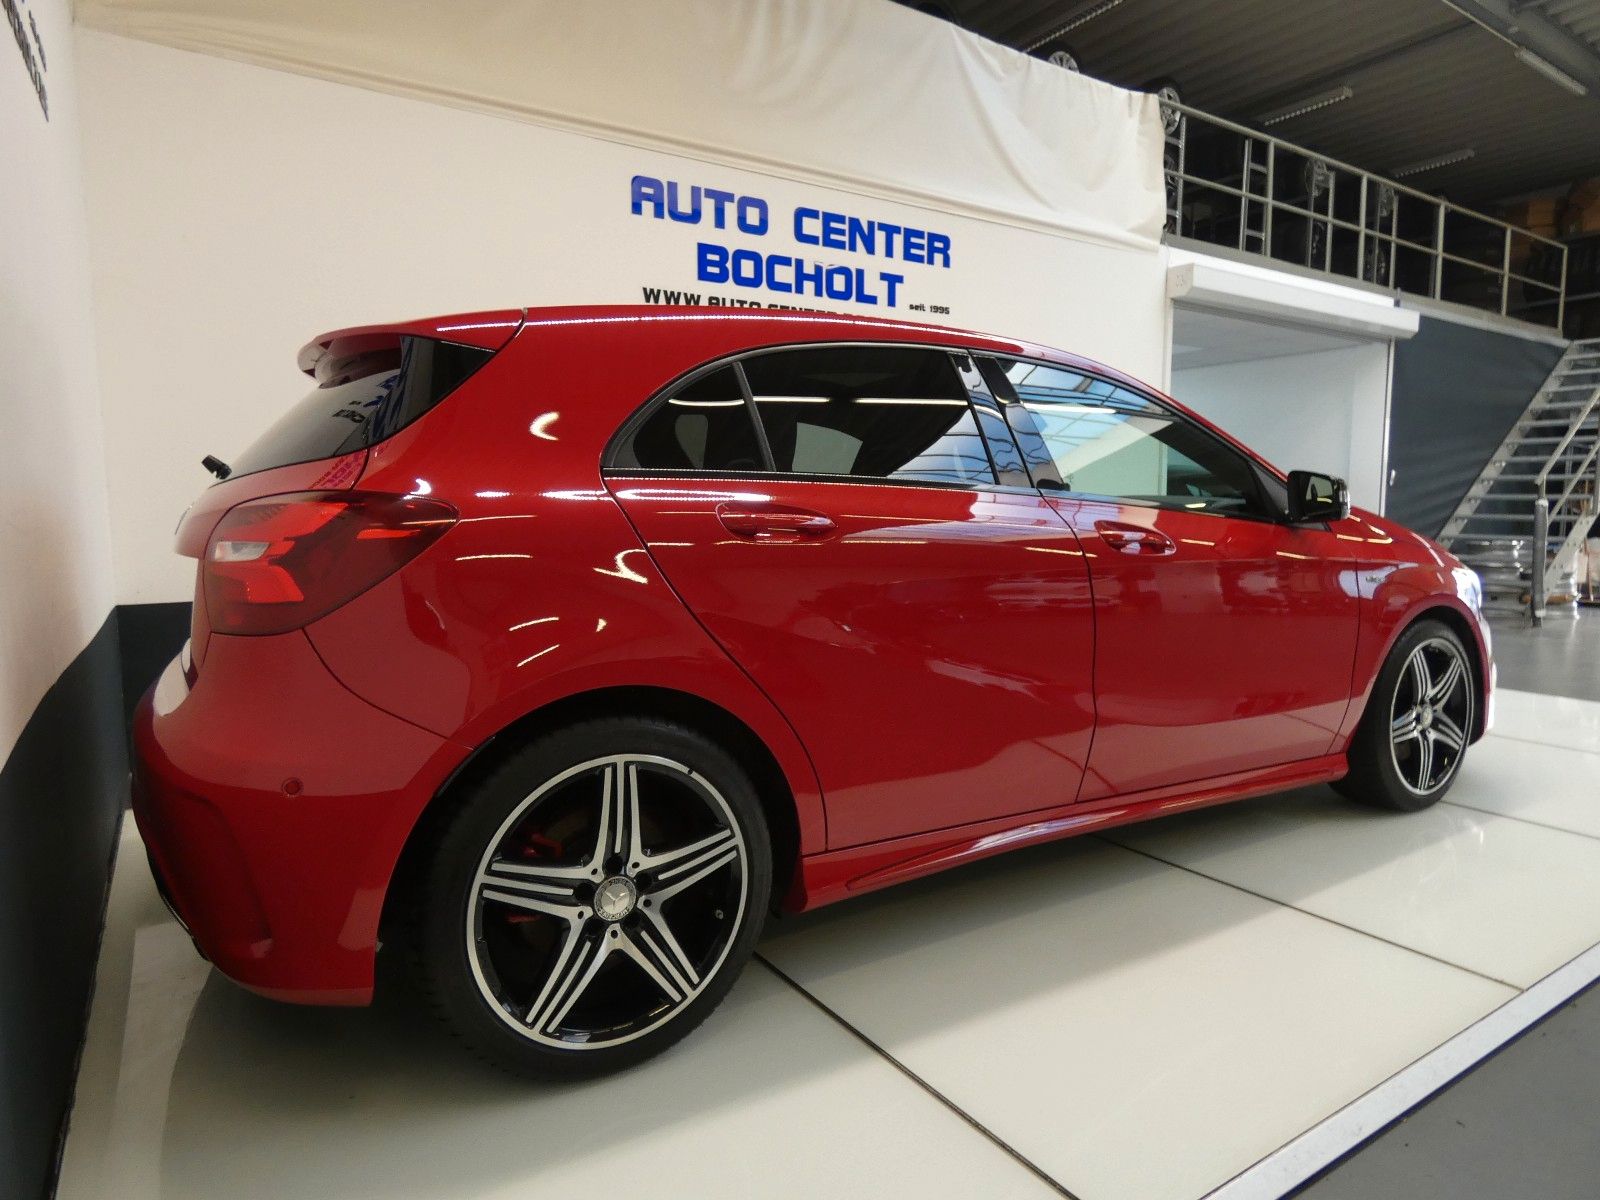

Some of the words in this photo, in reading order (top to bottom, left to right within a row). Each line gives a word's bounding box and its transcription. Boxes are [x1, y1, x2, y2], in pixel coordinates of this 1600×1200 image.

[631, 175, 769, 236] AUTO
[794, 206, 951, 268] CENTER
[696, 242, 904, 307] BOCHOLT
[909, 303, 926, 312] seit
[930, 305, 950, 315] 1995
